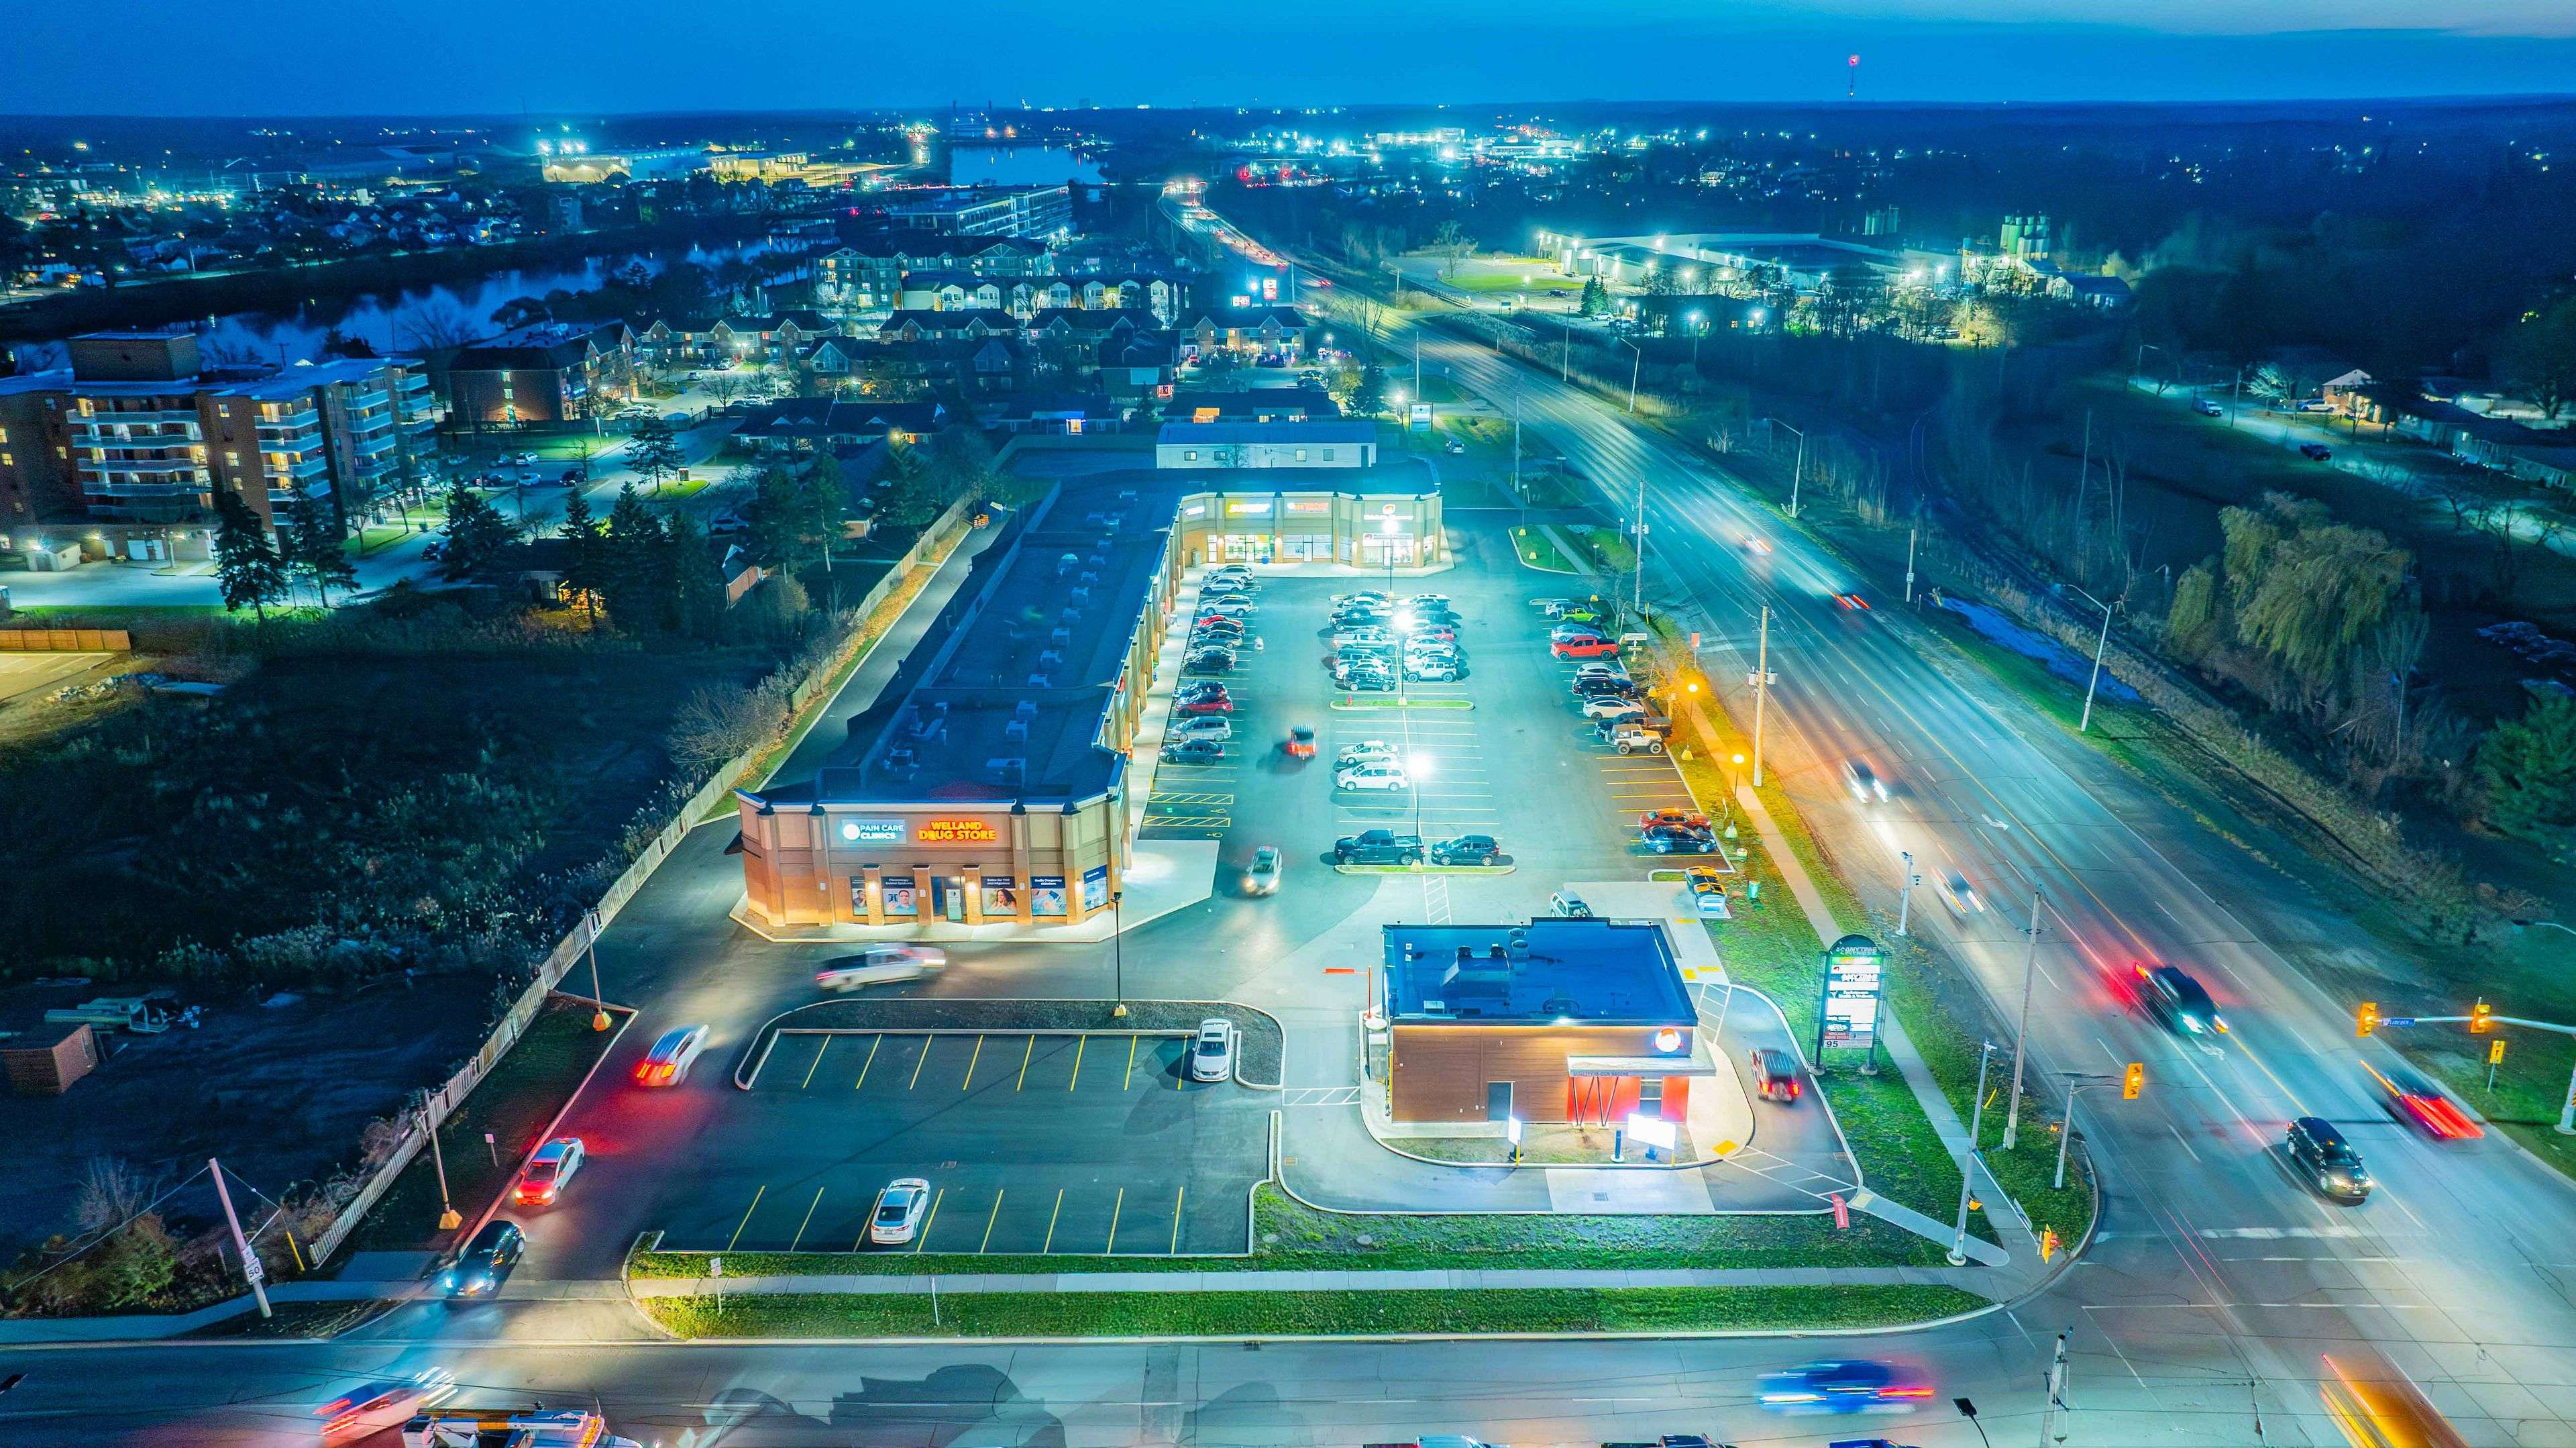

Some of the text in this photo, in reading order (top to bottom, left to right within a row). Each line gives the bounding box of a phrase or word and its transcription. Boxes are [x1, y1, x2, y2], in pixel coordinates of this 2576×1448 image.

[930, 821, 983, 831] WELLAND
[918, 830, 996, 841] DRUG STORE
[248, 1266, 260, 1278] 50
